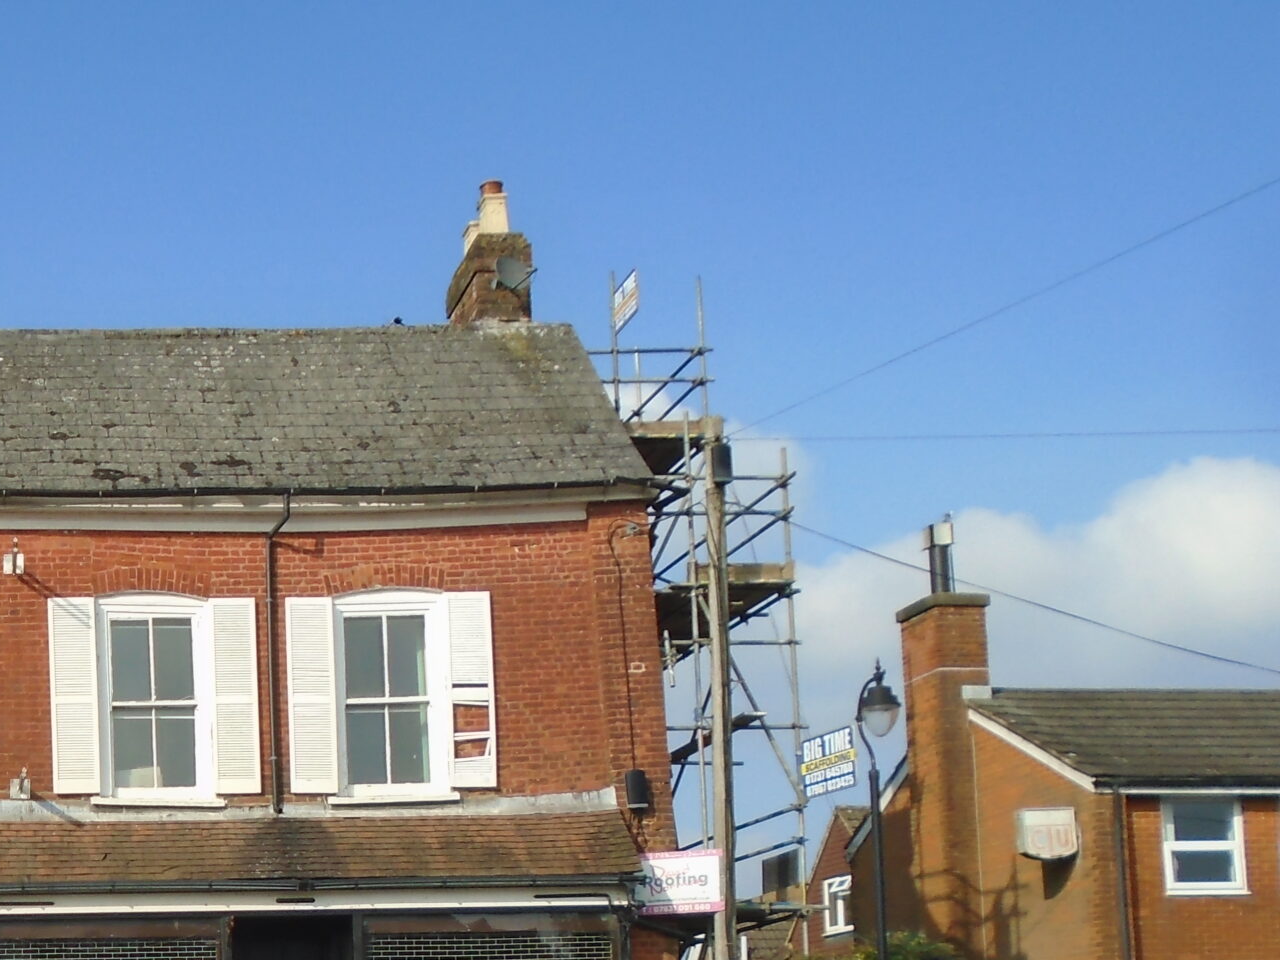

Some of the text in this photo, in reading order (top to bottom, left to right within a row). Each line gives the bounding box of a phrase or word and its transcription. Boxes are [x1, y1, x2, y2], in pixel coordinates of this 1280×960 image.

[803, 728, 851, 762] BIG TIME
[805, 750, 851, 773] SCAFFOLDING
[643, 872, 708, 888] Roofing
